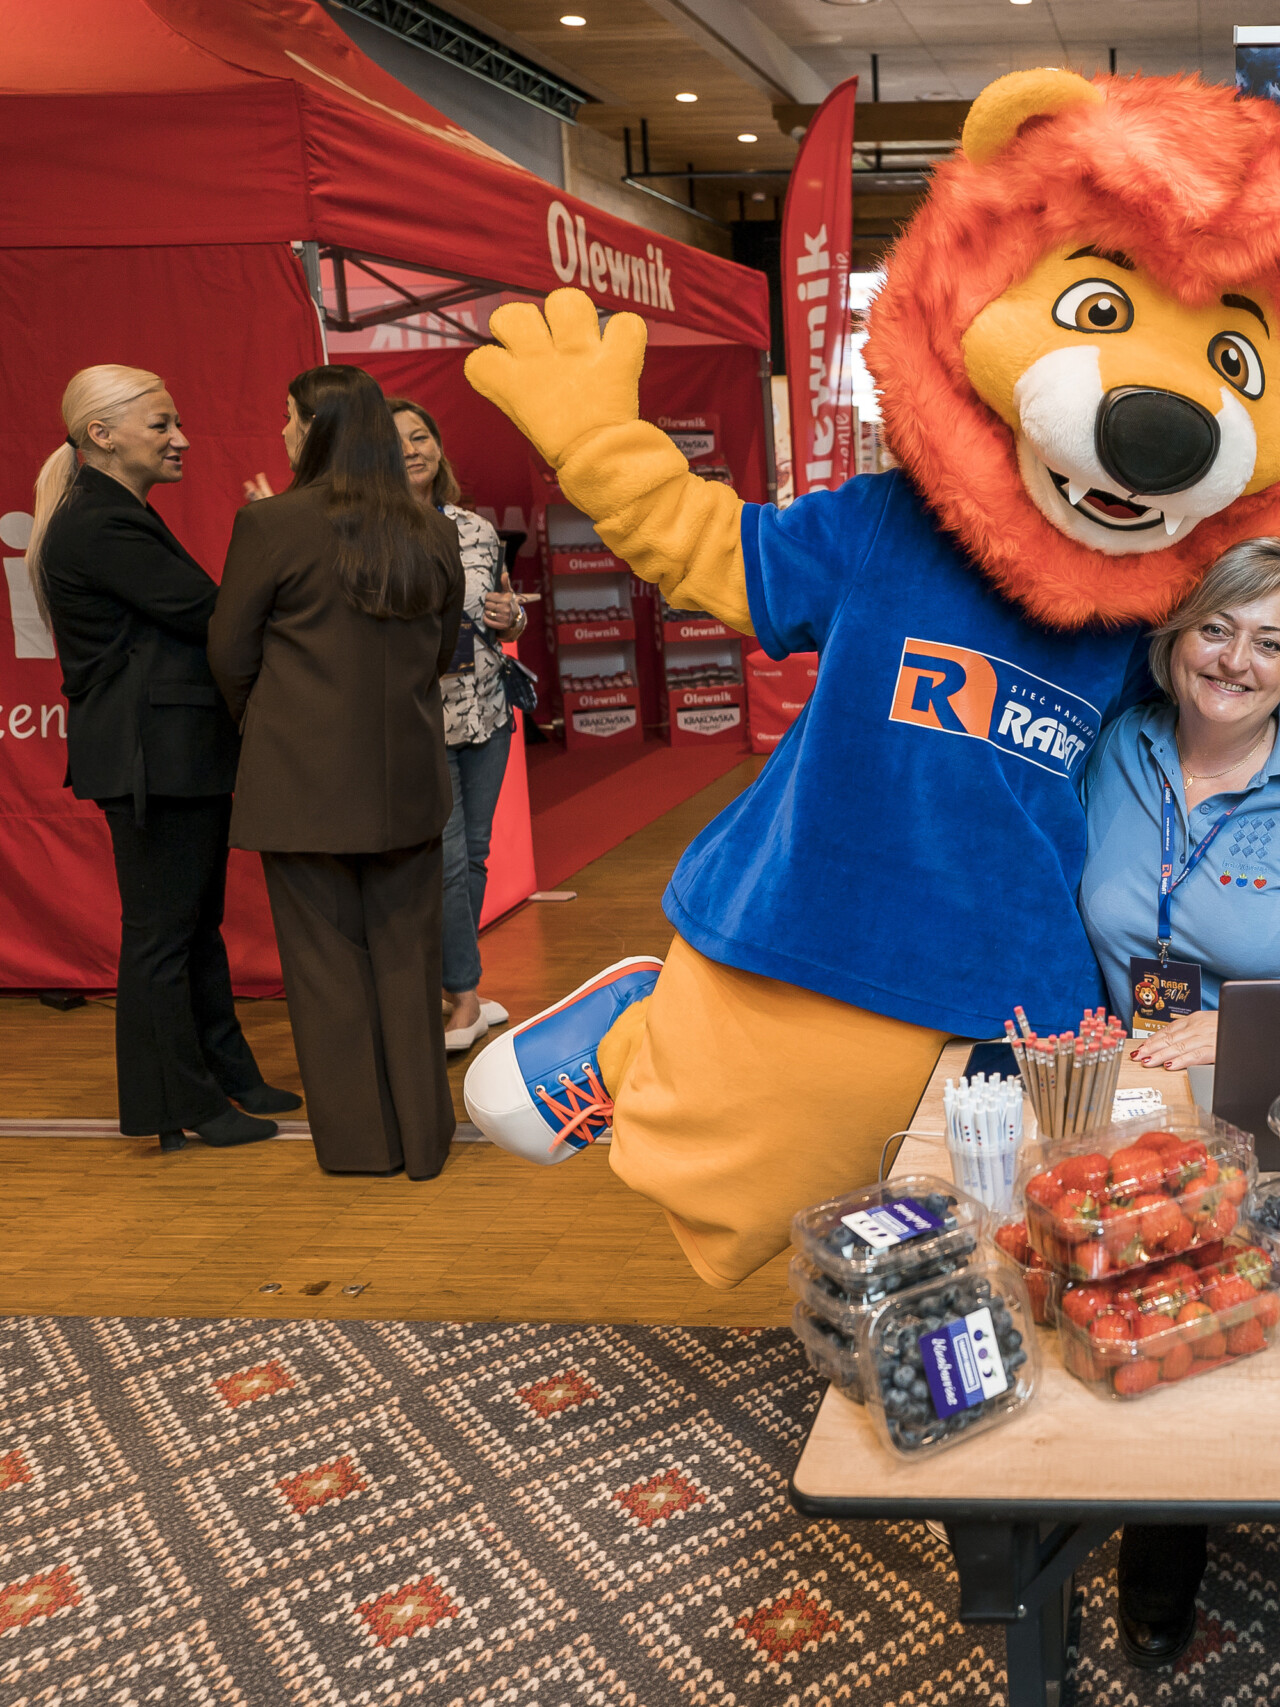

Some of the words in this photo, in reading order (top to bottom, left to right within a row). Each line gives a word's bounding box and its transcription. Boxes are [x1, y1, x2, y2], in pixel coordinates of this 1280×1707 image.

[547, 201, 676, 311] Olewnik
[797, 223, 834, 493] lewnik
[680, 625, 727, 638] Olewnik
[578, 692, 628, 707] Olewnik
[683, 691, 732, 705] Olewnik
[1010, 684, 1046, 705] SIEĆ
[1160, 979, 1189, 990] RABAT
